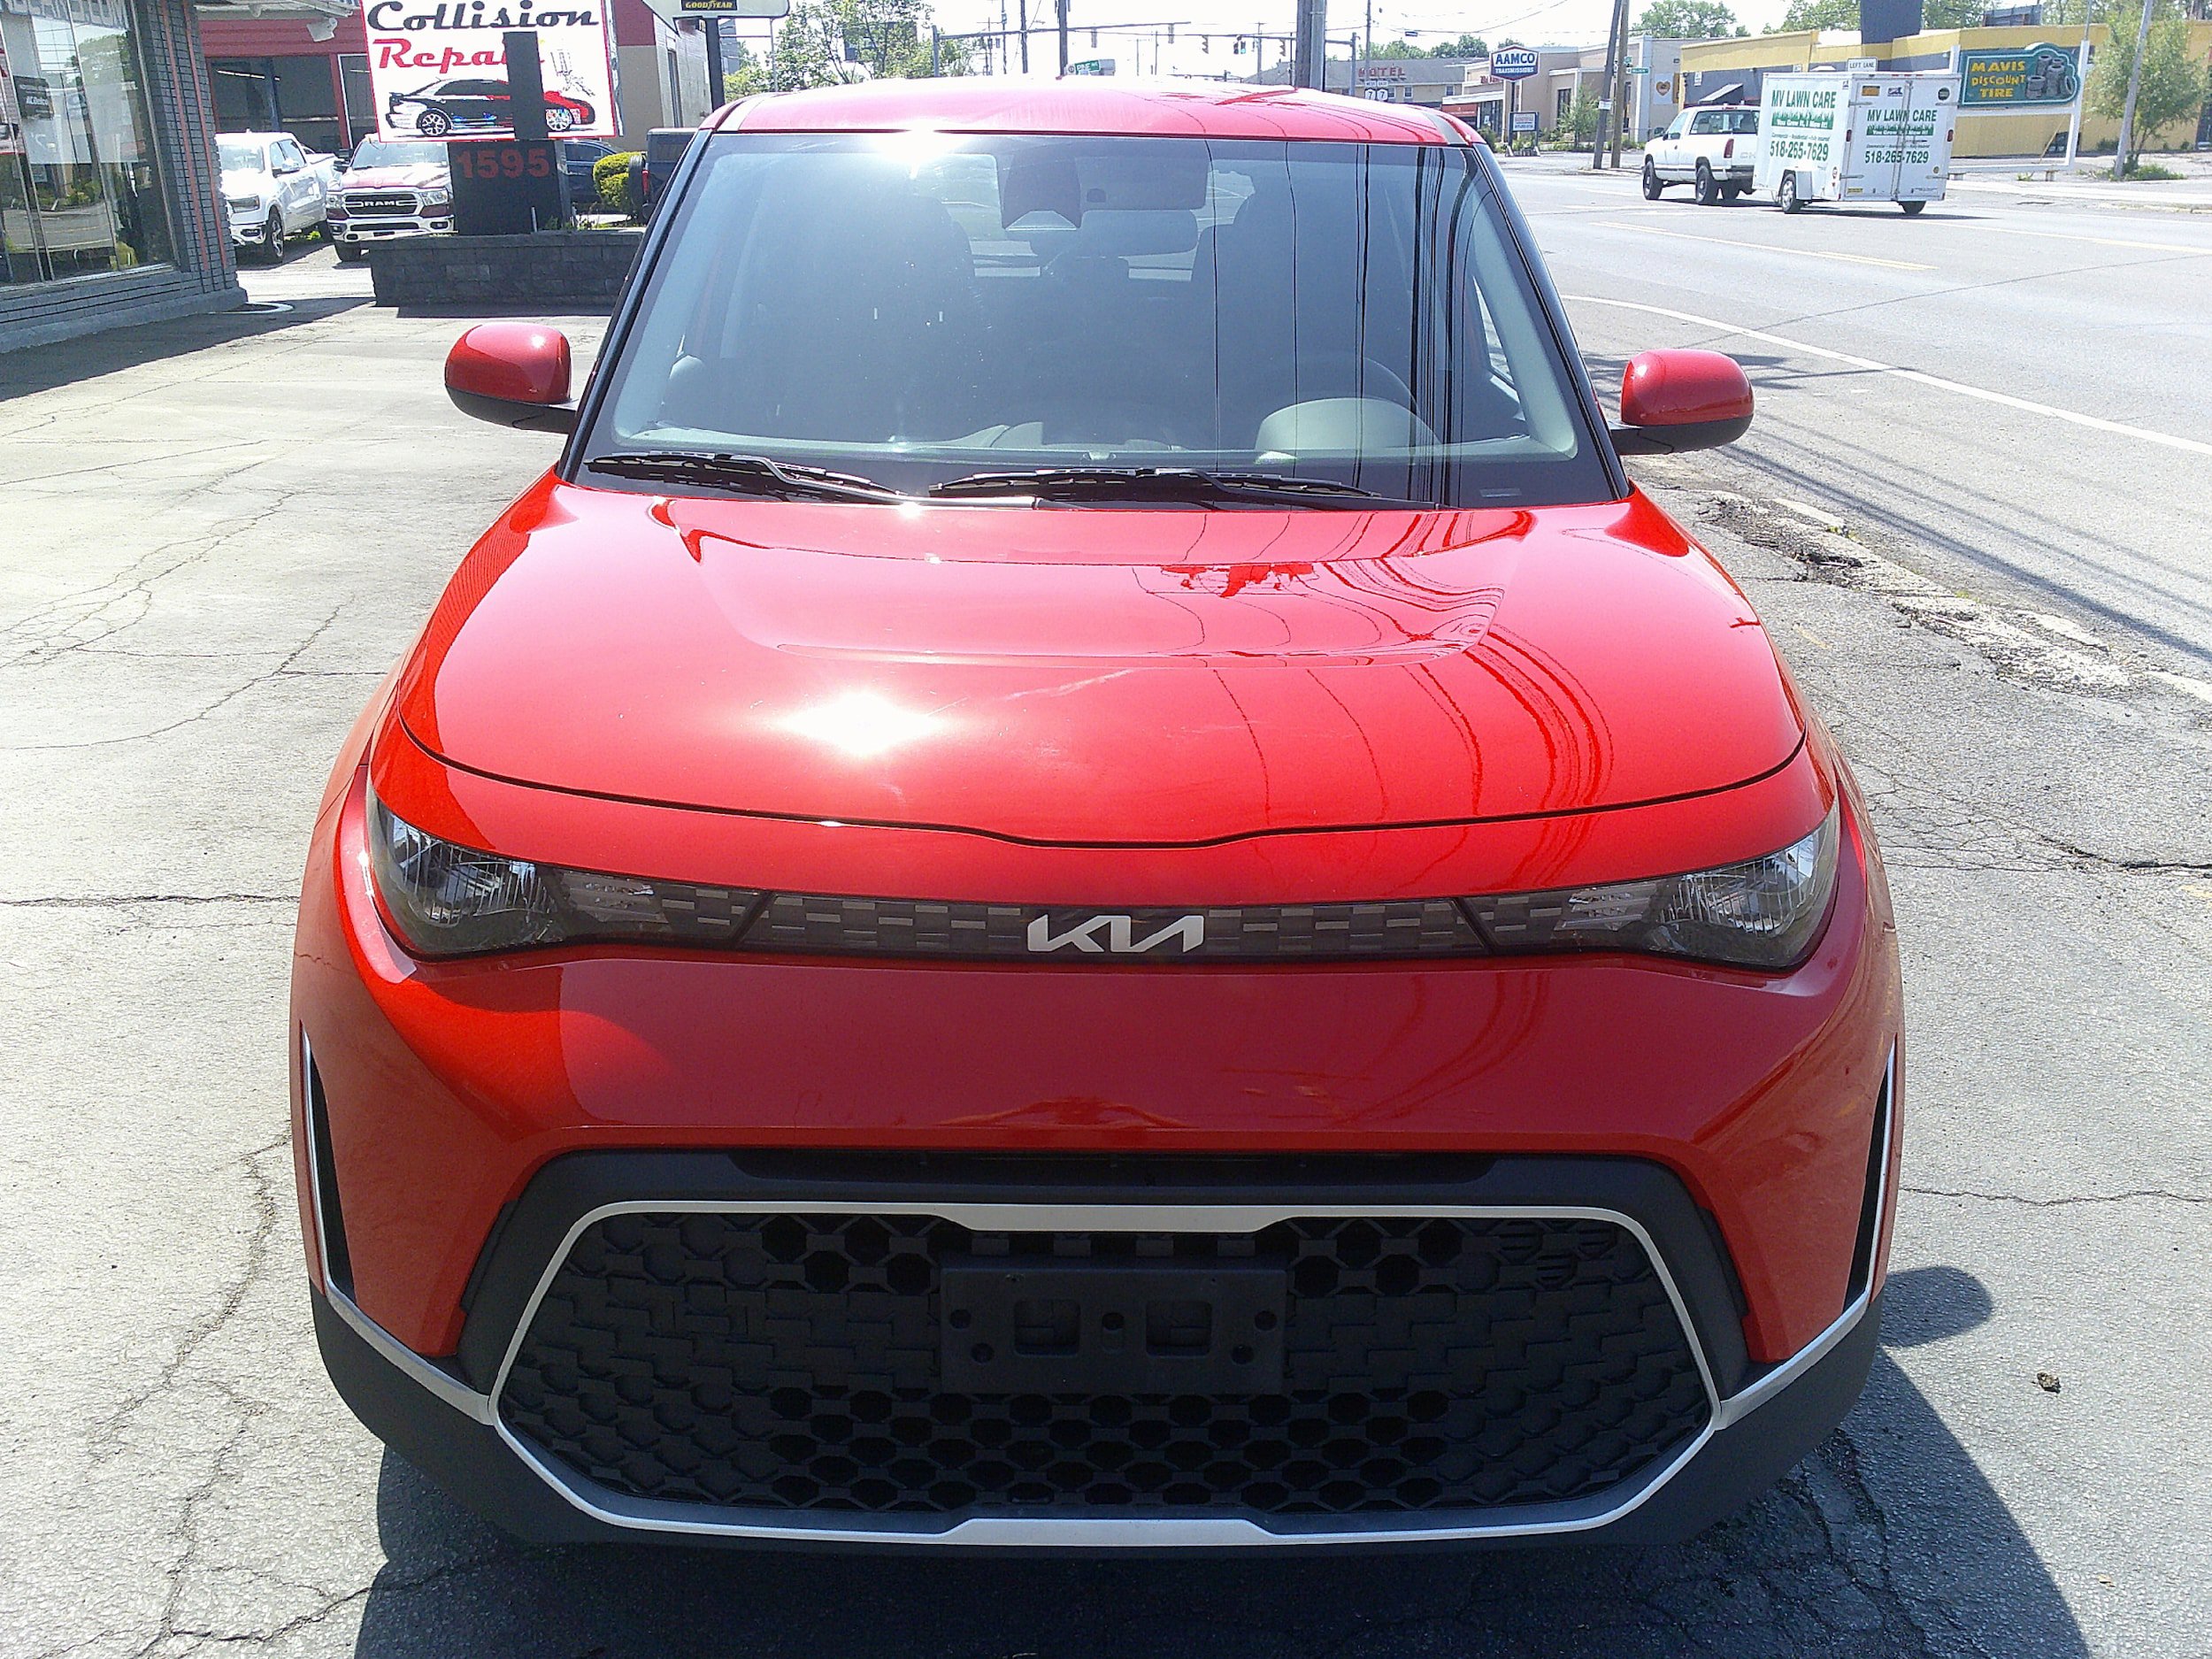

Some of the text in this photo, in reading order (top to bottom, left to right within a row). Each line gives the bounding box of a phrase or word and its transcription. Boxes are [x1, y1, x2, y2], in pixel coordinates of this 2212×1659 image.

[685, 0, 733, 9] GOODYEAR
[367, 0, 600, 32] Collision
[373, 38, 546, 74] Repa
[1495, 53, 1535, 65] AAMCO
[1970, 61, 2025, 73] MAVIS
[1971, 73, 2026, 87] DISCOUNT
[1771, 89, 1837, 109] MV LAWN CARE
[1980, 88, 2014, 97] TIRE
[1867, 109, 1938, 122] MV LAWN CARE
[1770, 141, 1829, 162] 518-265-7629
[1864, 150, 1930, 164] 518-265-7629
[457, 148, 549, 179] 1595
[1027, 914, 1204, 953] KIA
